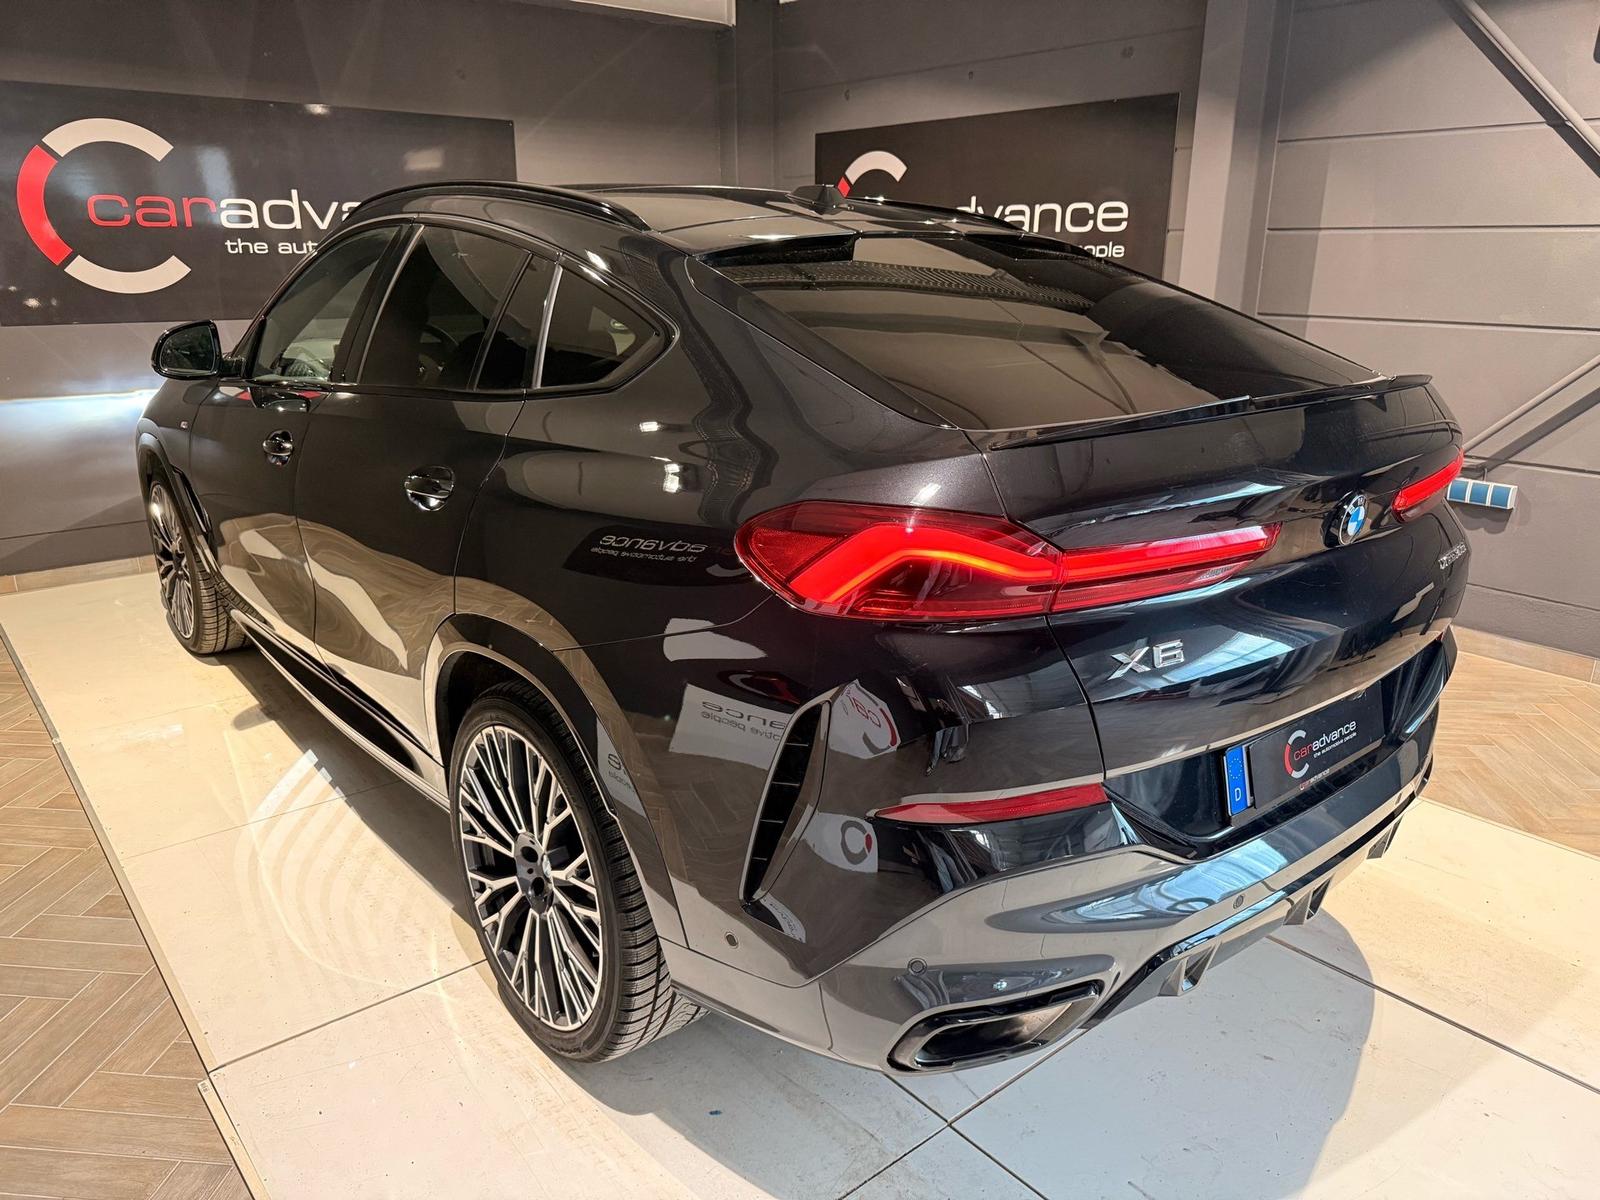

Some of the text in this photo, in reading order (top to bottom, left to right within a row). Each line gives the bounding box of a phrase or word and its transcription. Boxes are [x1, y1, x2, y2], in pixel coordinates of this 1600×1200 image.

[225, 238, 269, 254] the
[1079, 241, 1125, 258] ople
[1107, 639, 1184, 680] X6
[1293, 720, 1357, 761] caradvance
[1234, 787, 1241, 802] D
